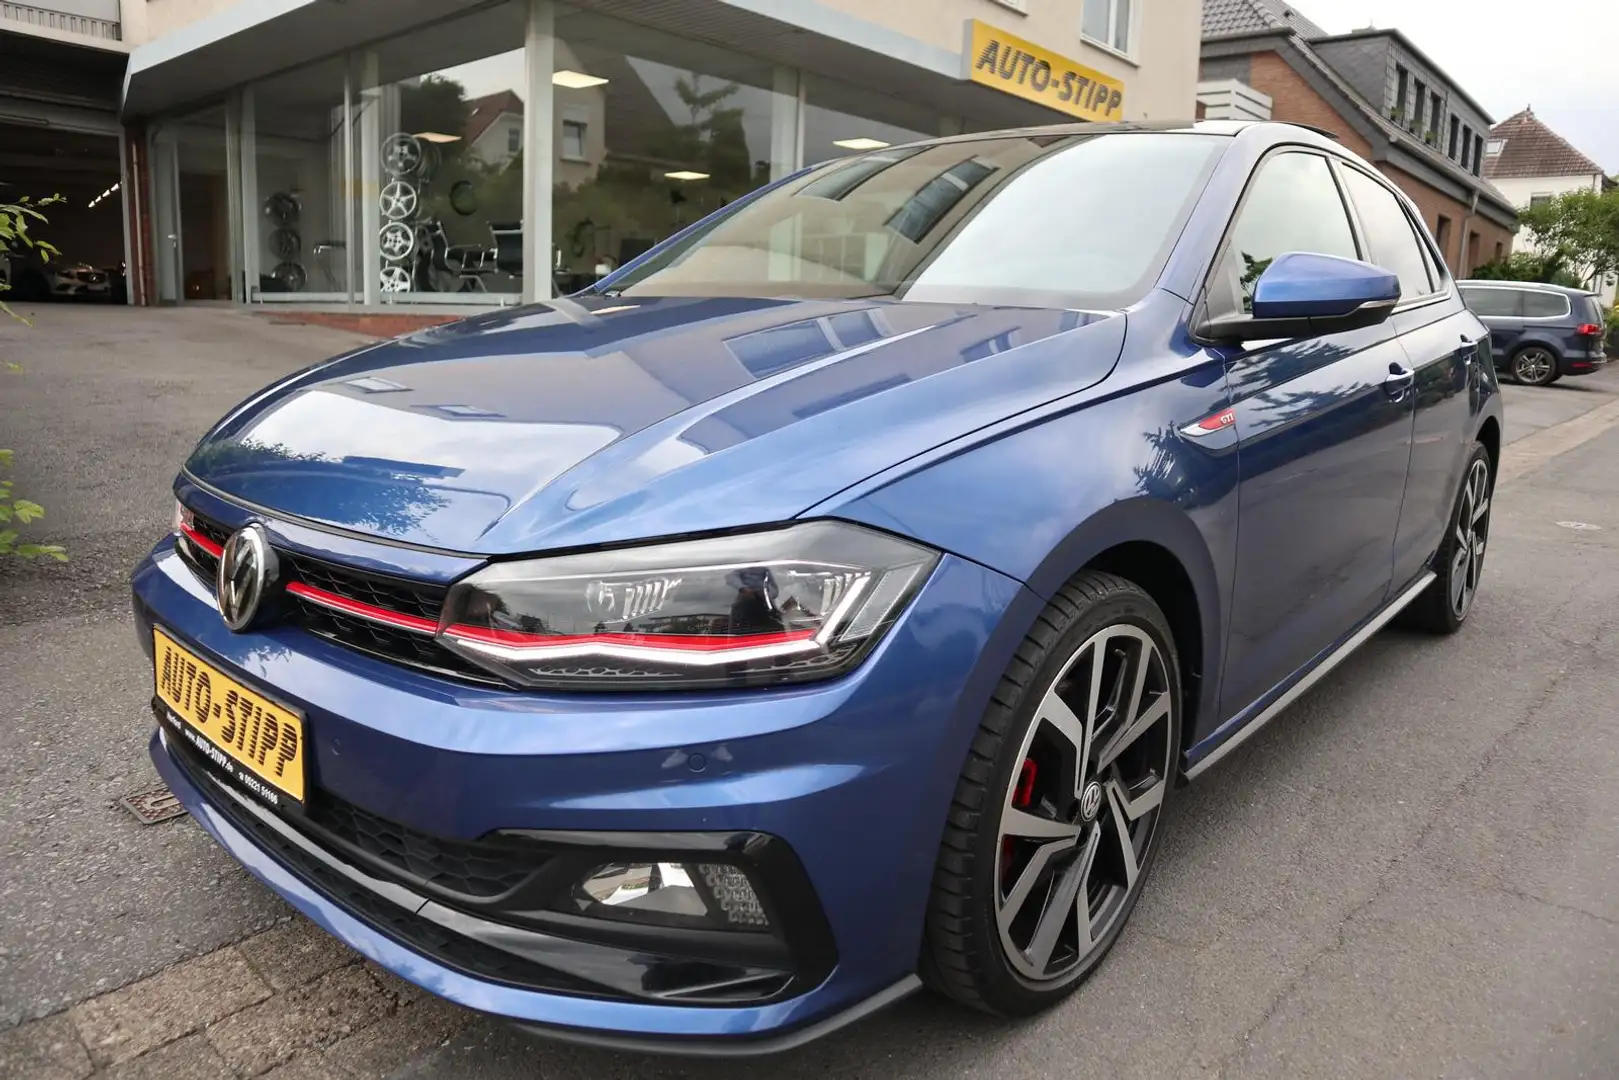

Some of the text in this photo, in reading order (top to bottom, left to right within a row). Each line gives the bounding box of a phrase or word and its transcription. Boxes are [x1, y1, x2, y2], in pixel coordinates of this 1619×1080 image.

[975, 39, 1122, 117] AUTO-STIPP
[1220, 412, 1234, 424] GTI
[160, 646, 298, 778] AUTO-STIPP
